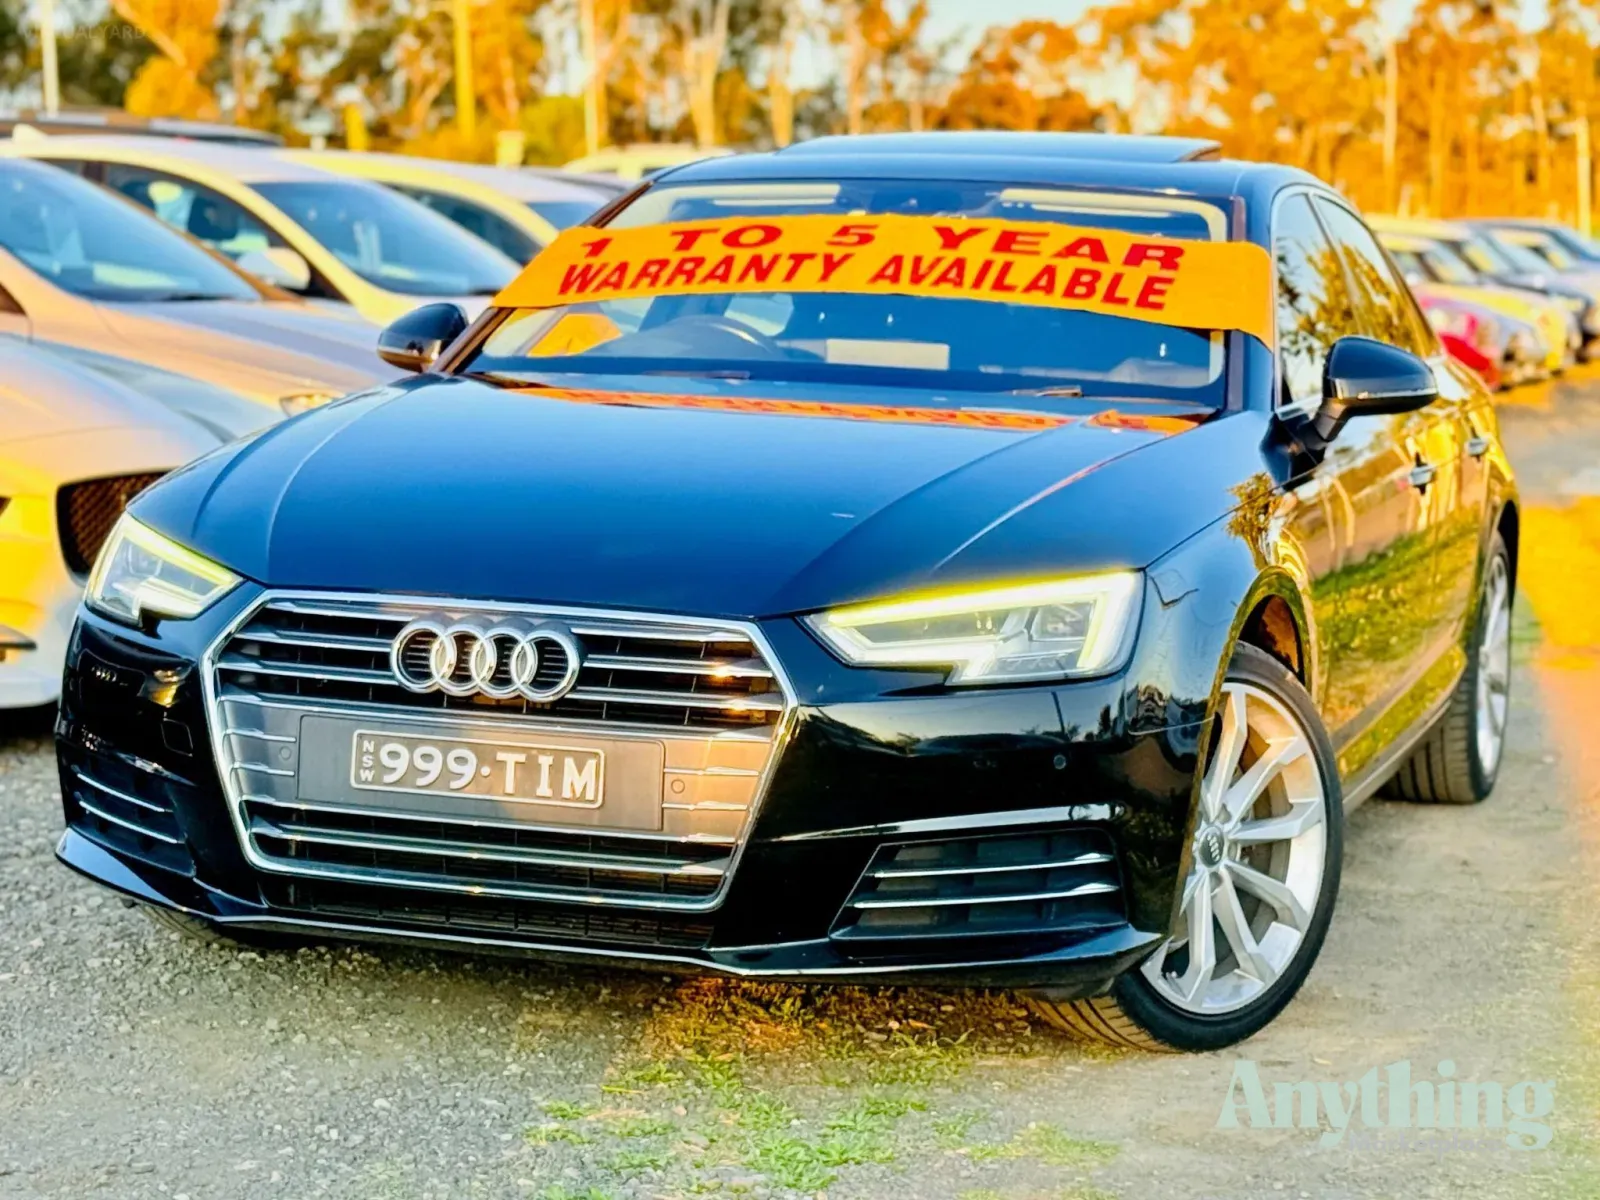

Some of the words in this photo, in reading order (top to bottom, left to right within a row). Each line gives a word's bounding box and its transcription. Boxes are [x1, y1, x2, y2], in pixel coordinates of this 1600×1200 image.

[581, 237, 613, 259] 1
[670, 224, 783, 252] TO
[826, 224, 880, 247] 5
[933, 226, 1185, 271] YEAR
[558, 253, 854, 296] WARRANTY
[866, 254, 1176, 311] AVAILABLE
